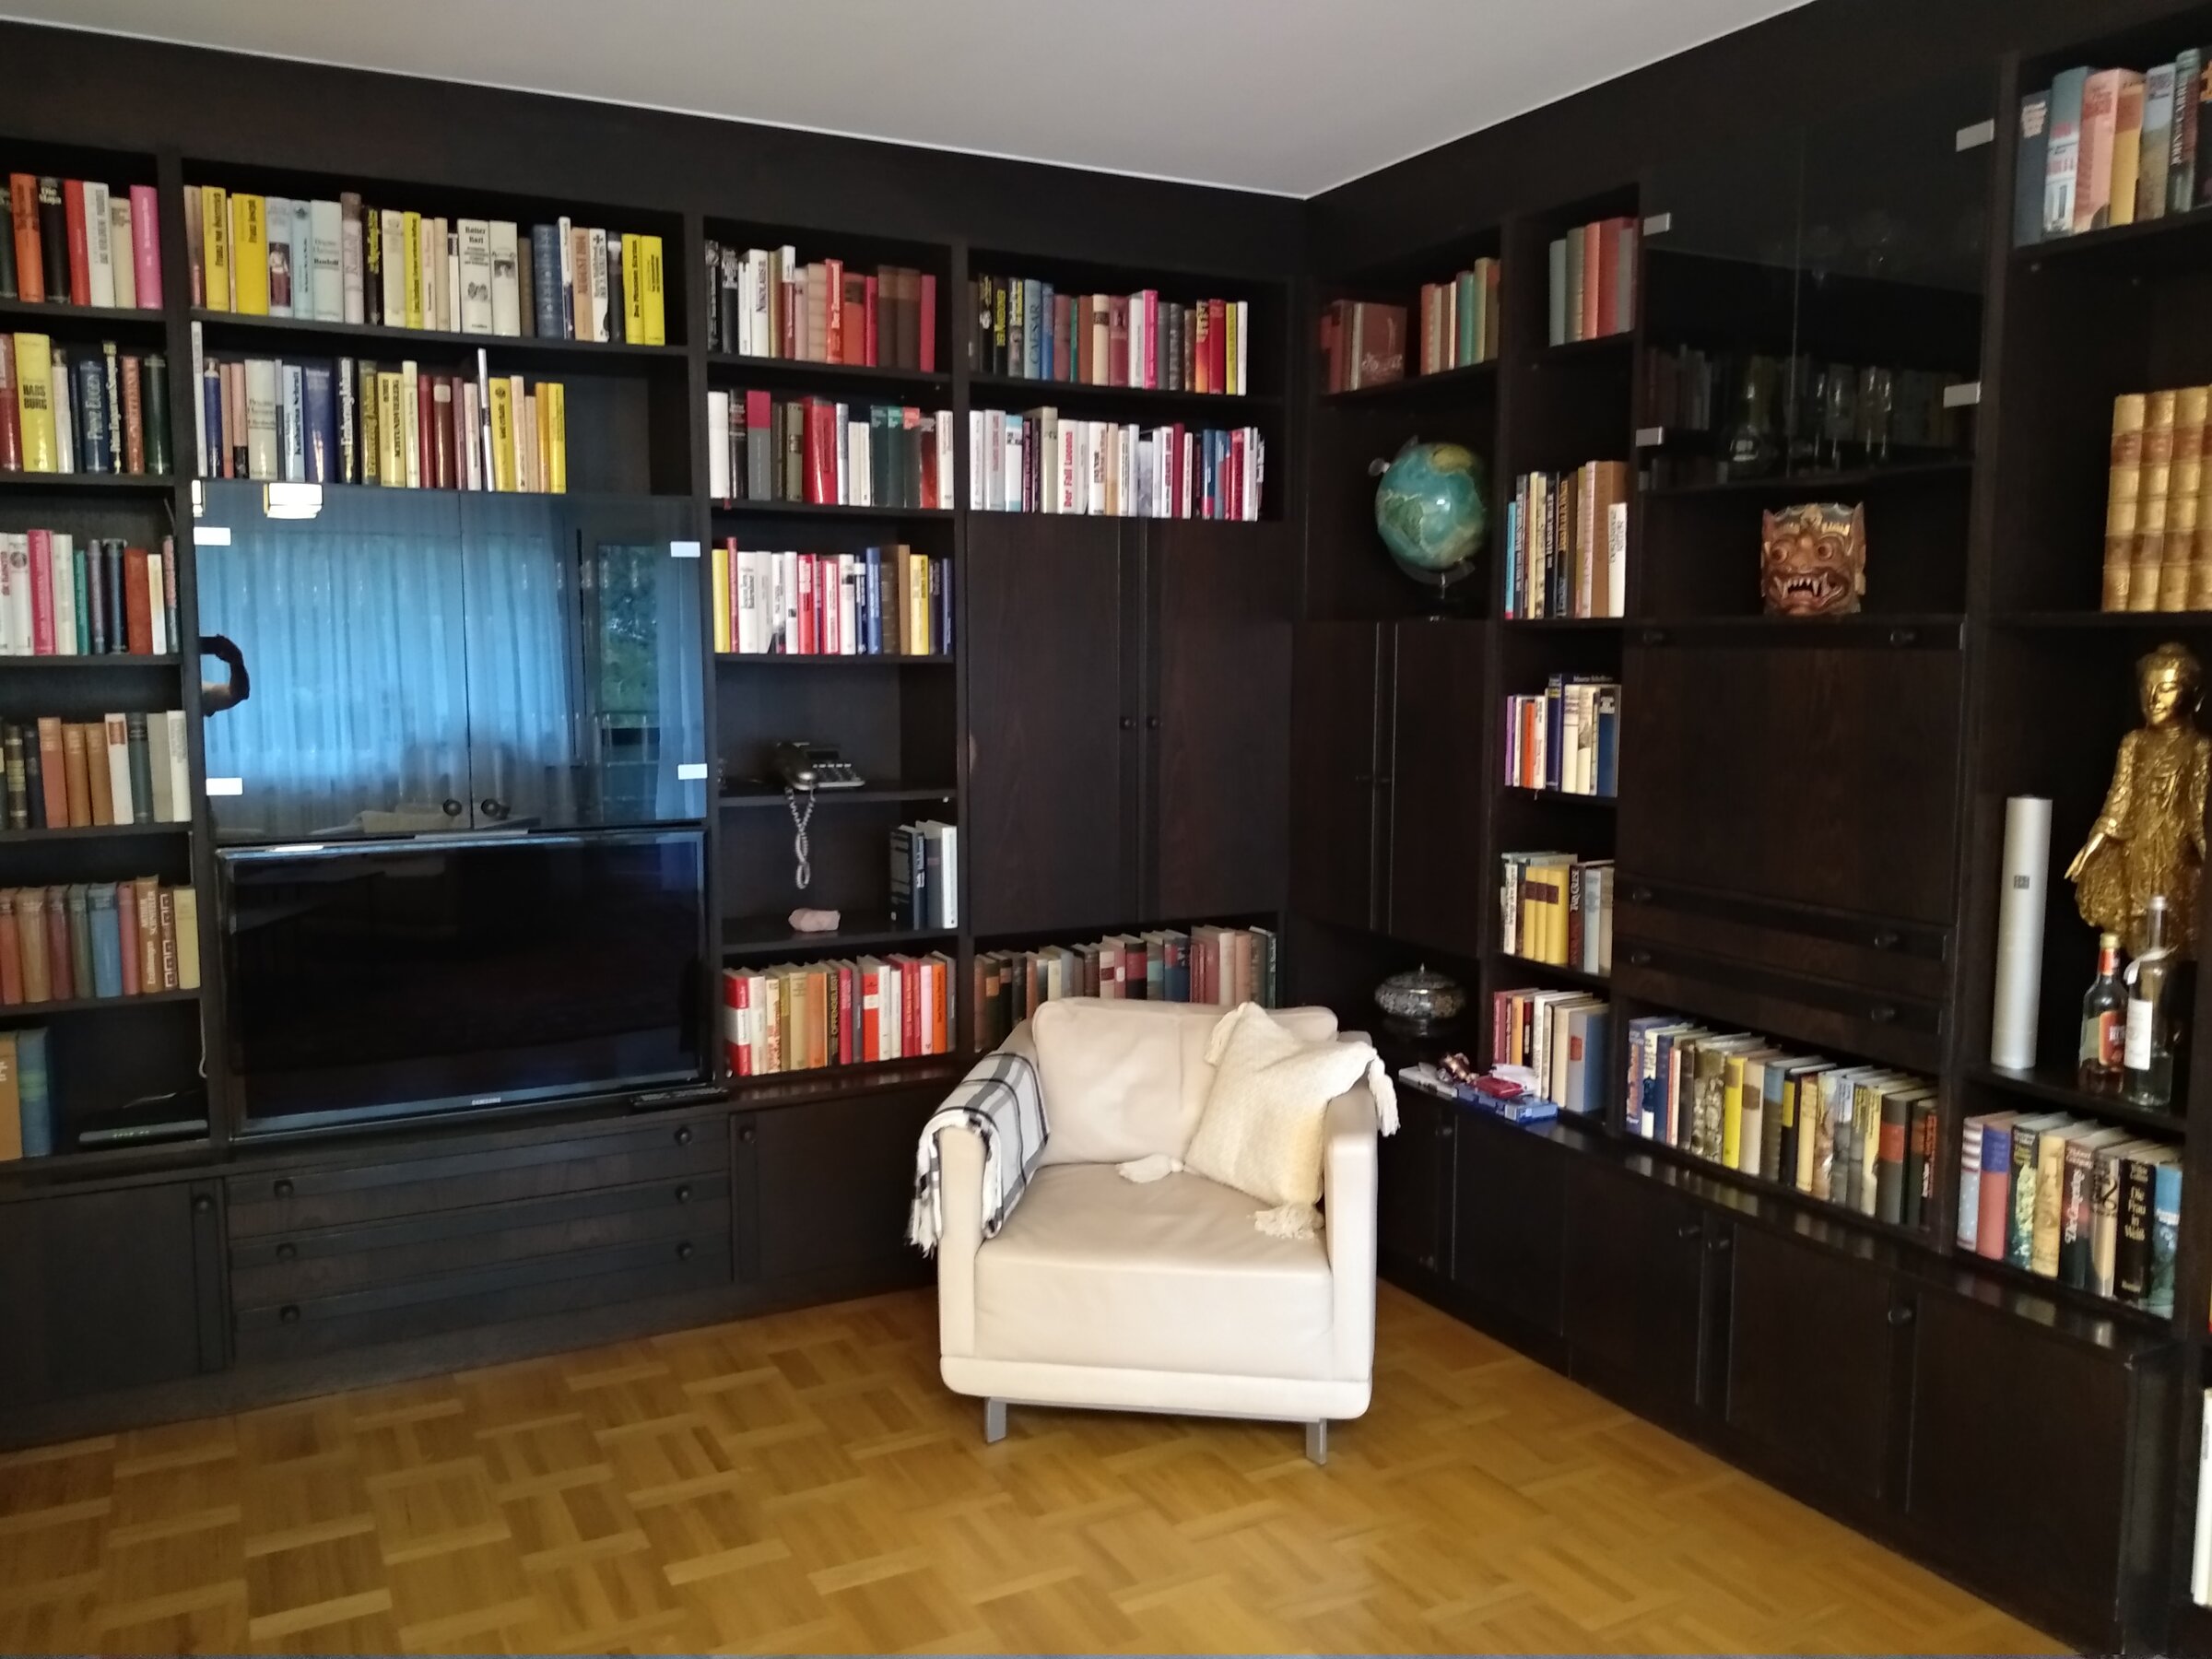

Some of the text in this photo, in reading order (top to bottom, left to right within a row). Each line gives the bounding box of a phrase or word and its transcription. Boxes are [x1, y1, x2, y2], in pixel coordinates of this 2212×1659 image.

[1029, 305, 1040, 364] CAESAR
[23, 384, 46, 396] HABS
[24, 398, 47, 410] BURG
[1064, 431, 1073, 507] Der Fall Lucona
[139, 898, 148, 928] ARTHUR
[471, 1097, 501, 1105] SAMSUNG
